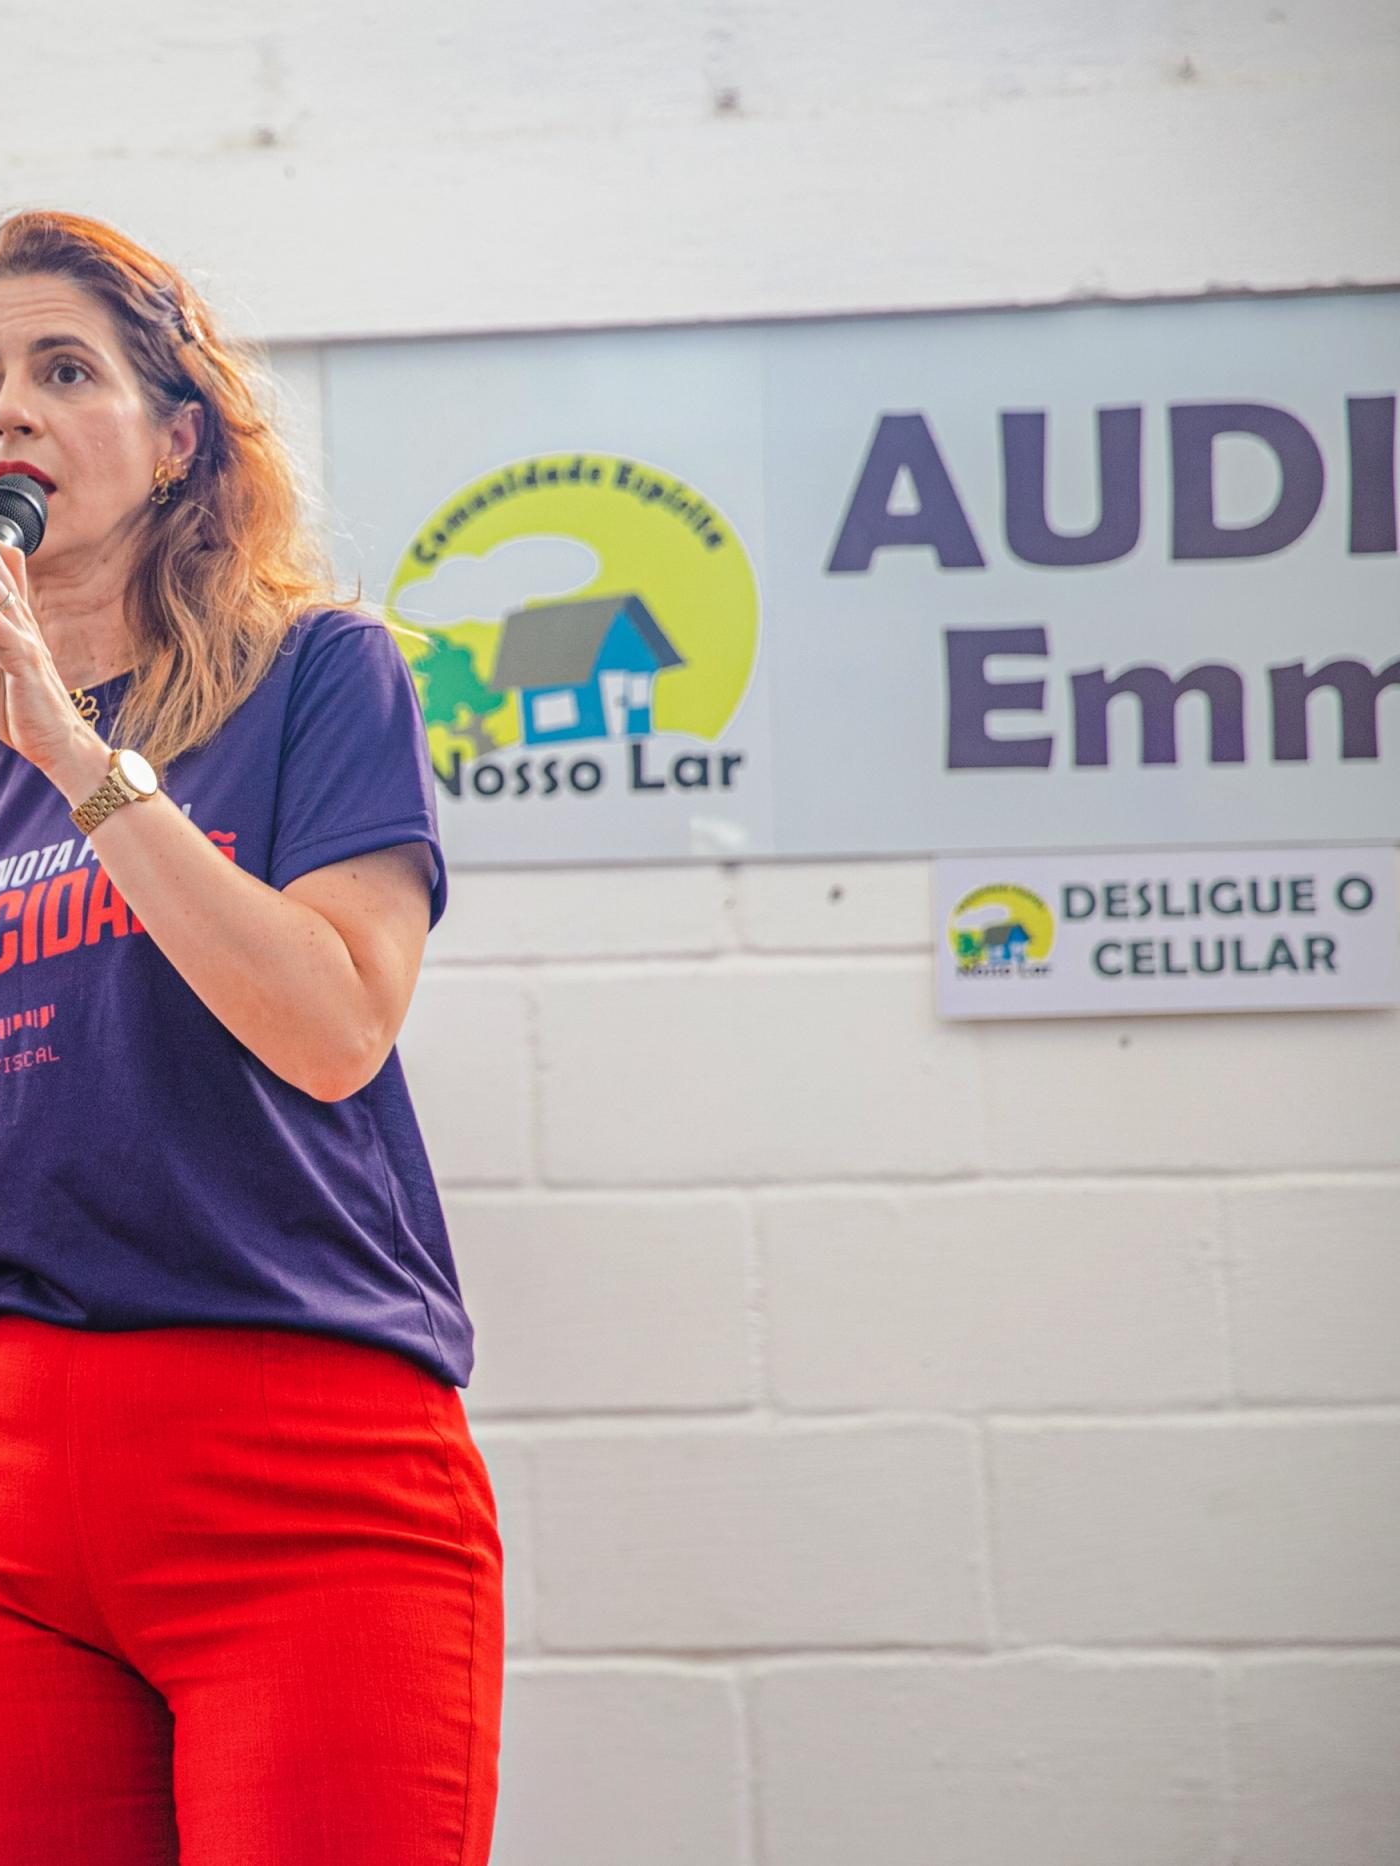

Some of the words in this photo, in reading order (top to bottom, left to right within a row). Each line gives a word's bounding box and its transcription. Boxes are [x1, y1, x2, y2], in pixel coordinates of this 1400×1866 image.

[825, 395, 1399, 573] AUDI
[414, 456, 602, 566] Comunidade
[631, 743, 743, 790] Lar
[1063, 878, 1318, 920] DESLIGUE
[1336, 876, 1374, 912] O
[1093, 936, 1337, 977] CELULAR
